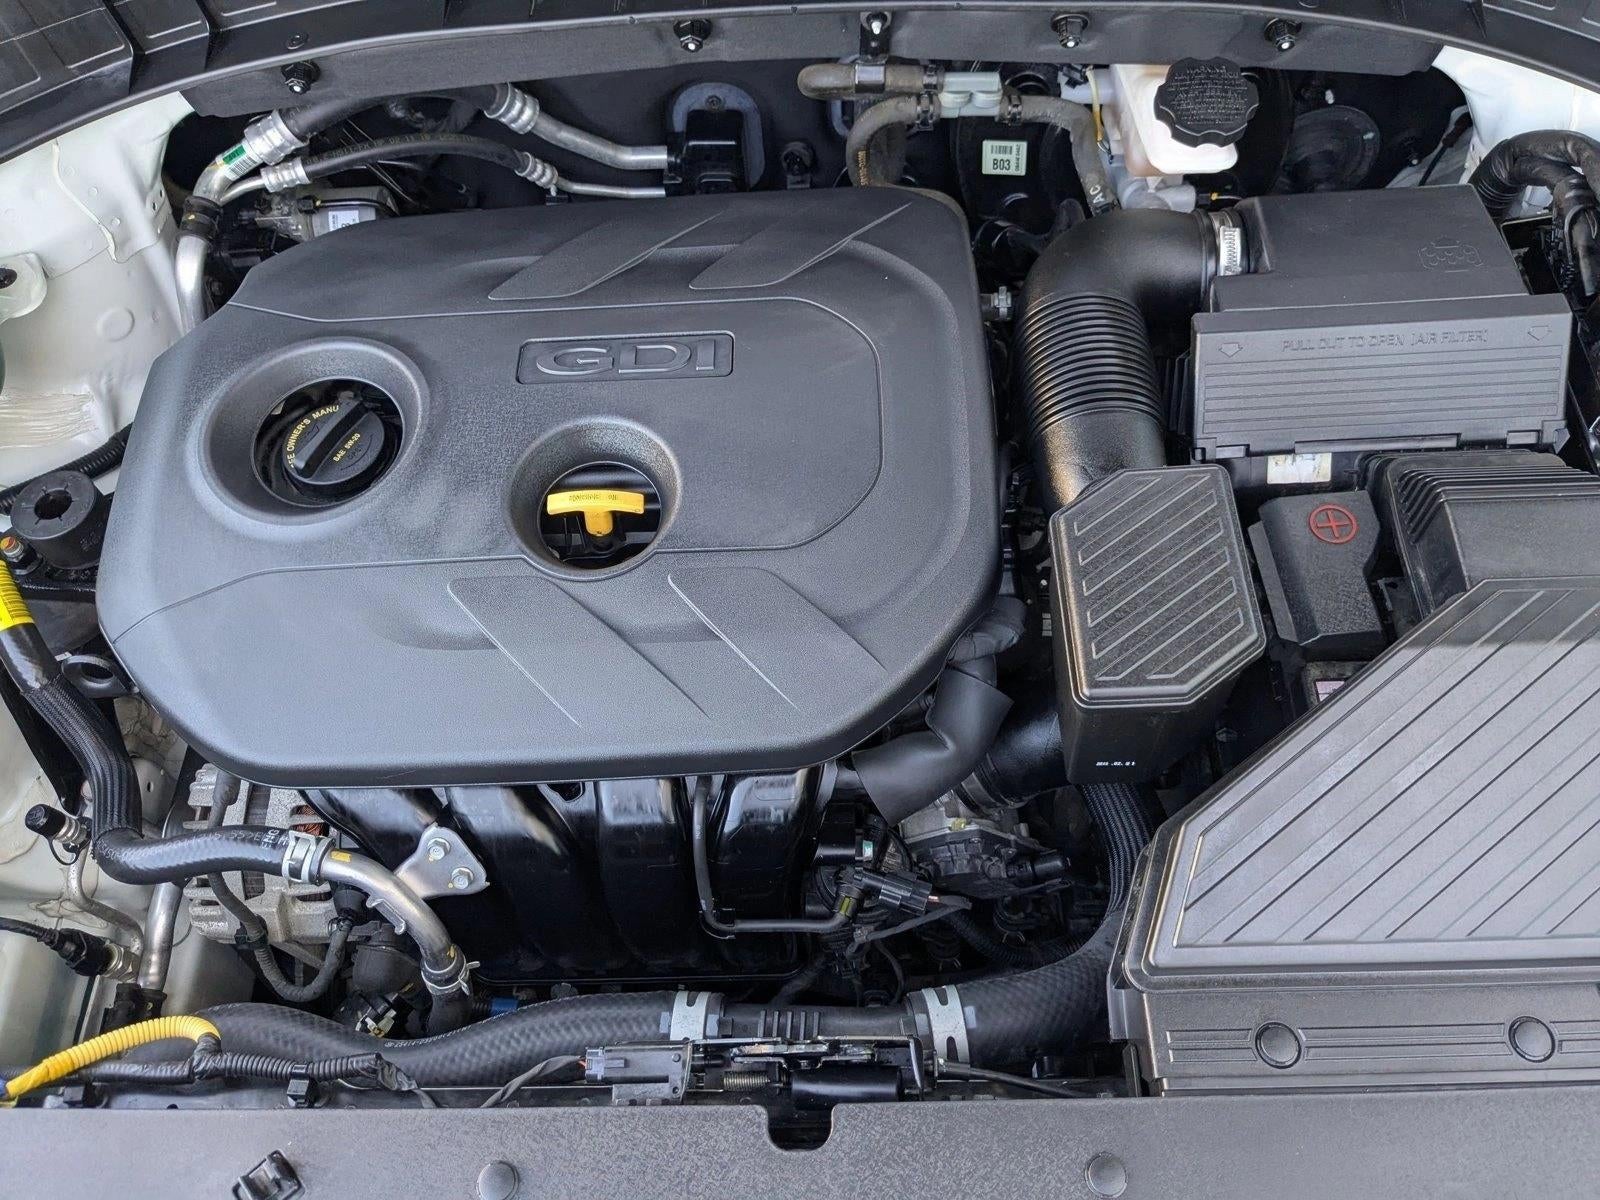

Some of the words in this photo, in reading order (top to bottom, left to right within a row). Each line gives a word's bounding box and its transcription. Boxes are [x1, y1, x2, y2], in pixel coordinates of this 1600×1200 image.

[536, 338, 716, 376] GDI
[1282, 338, 1315, 351] PULL
[1319, 337, 1345, 350] OUT
[1348, 335, 1364, 348] TO
[1368, 334, 1404, 347] OPEN
[286, 418, 311, 452] OWNER'S
[333, 449, 347, 462] SAE
[344, 432, 361, 450] 5W-20
